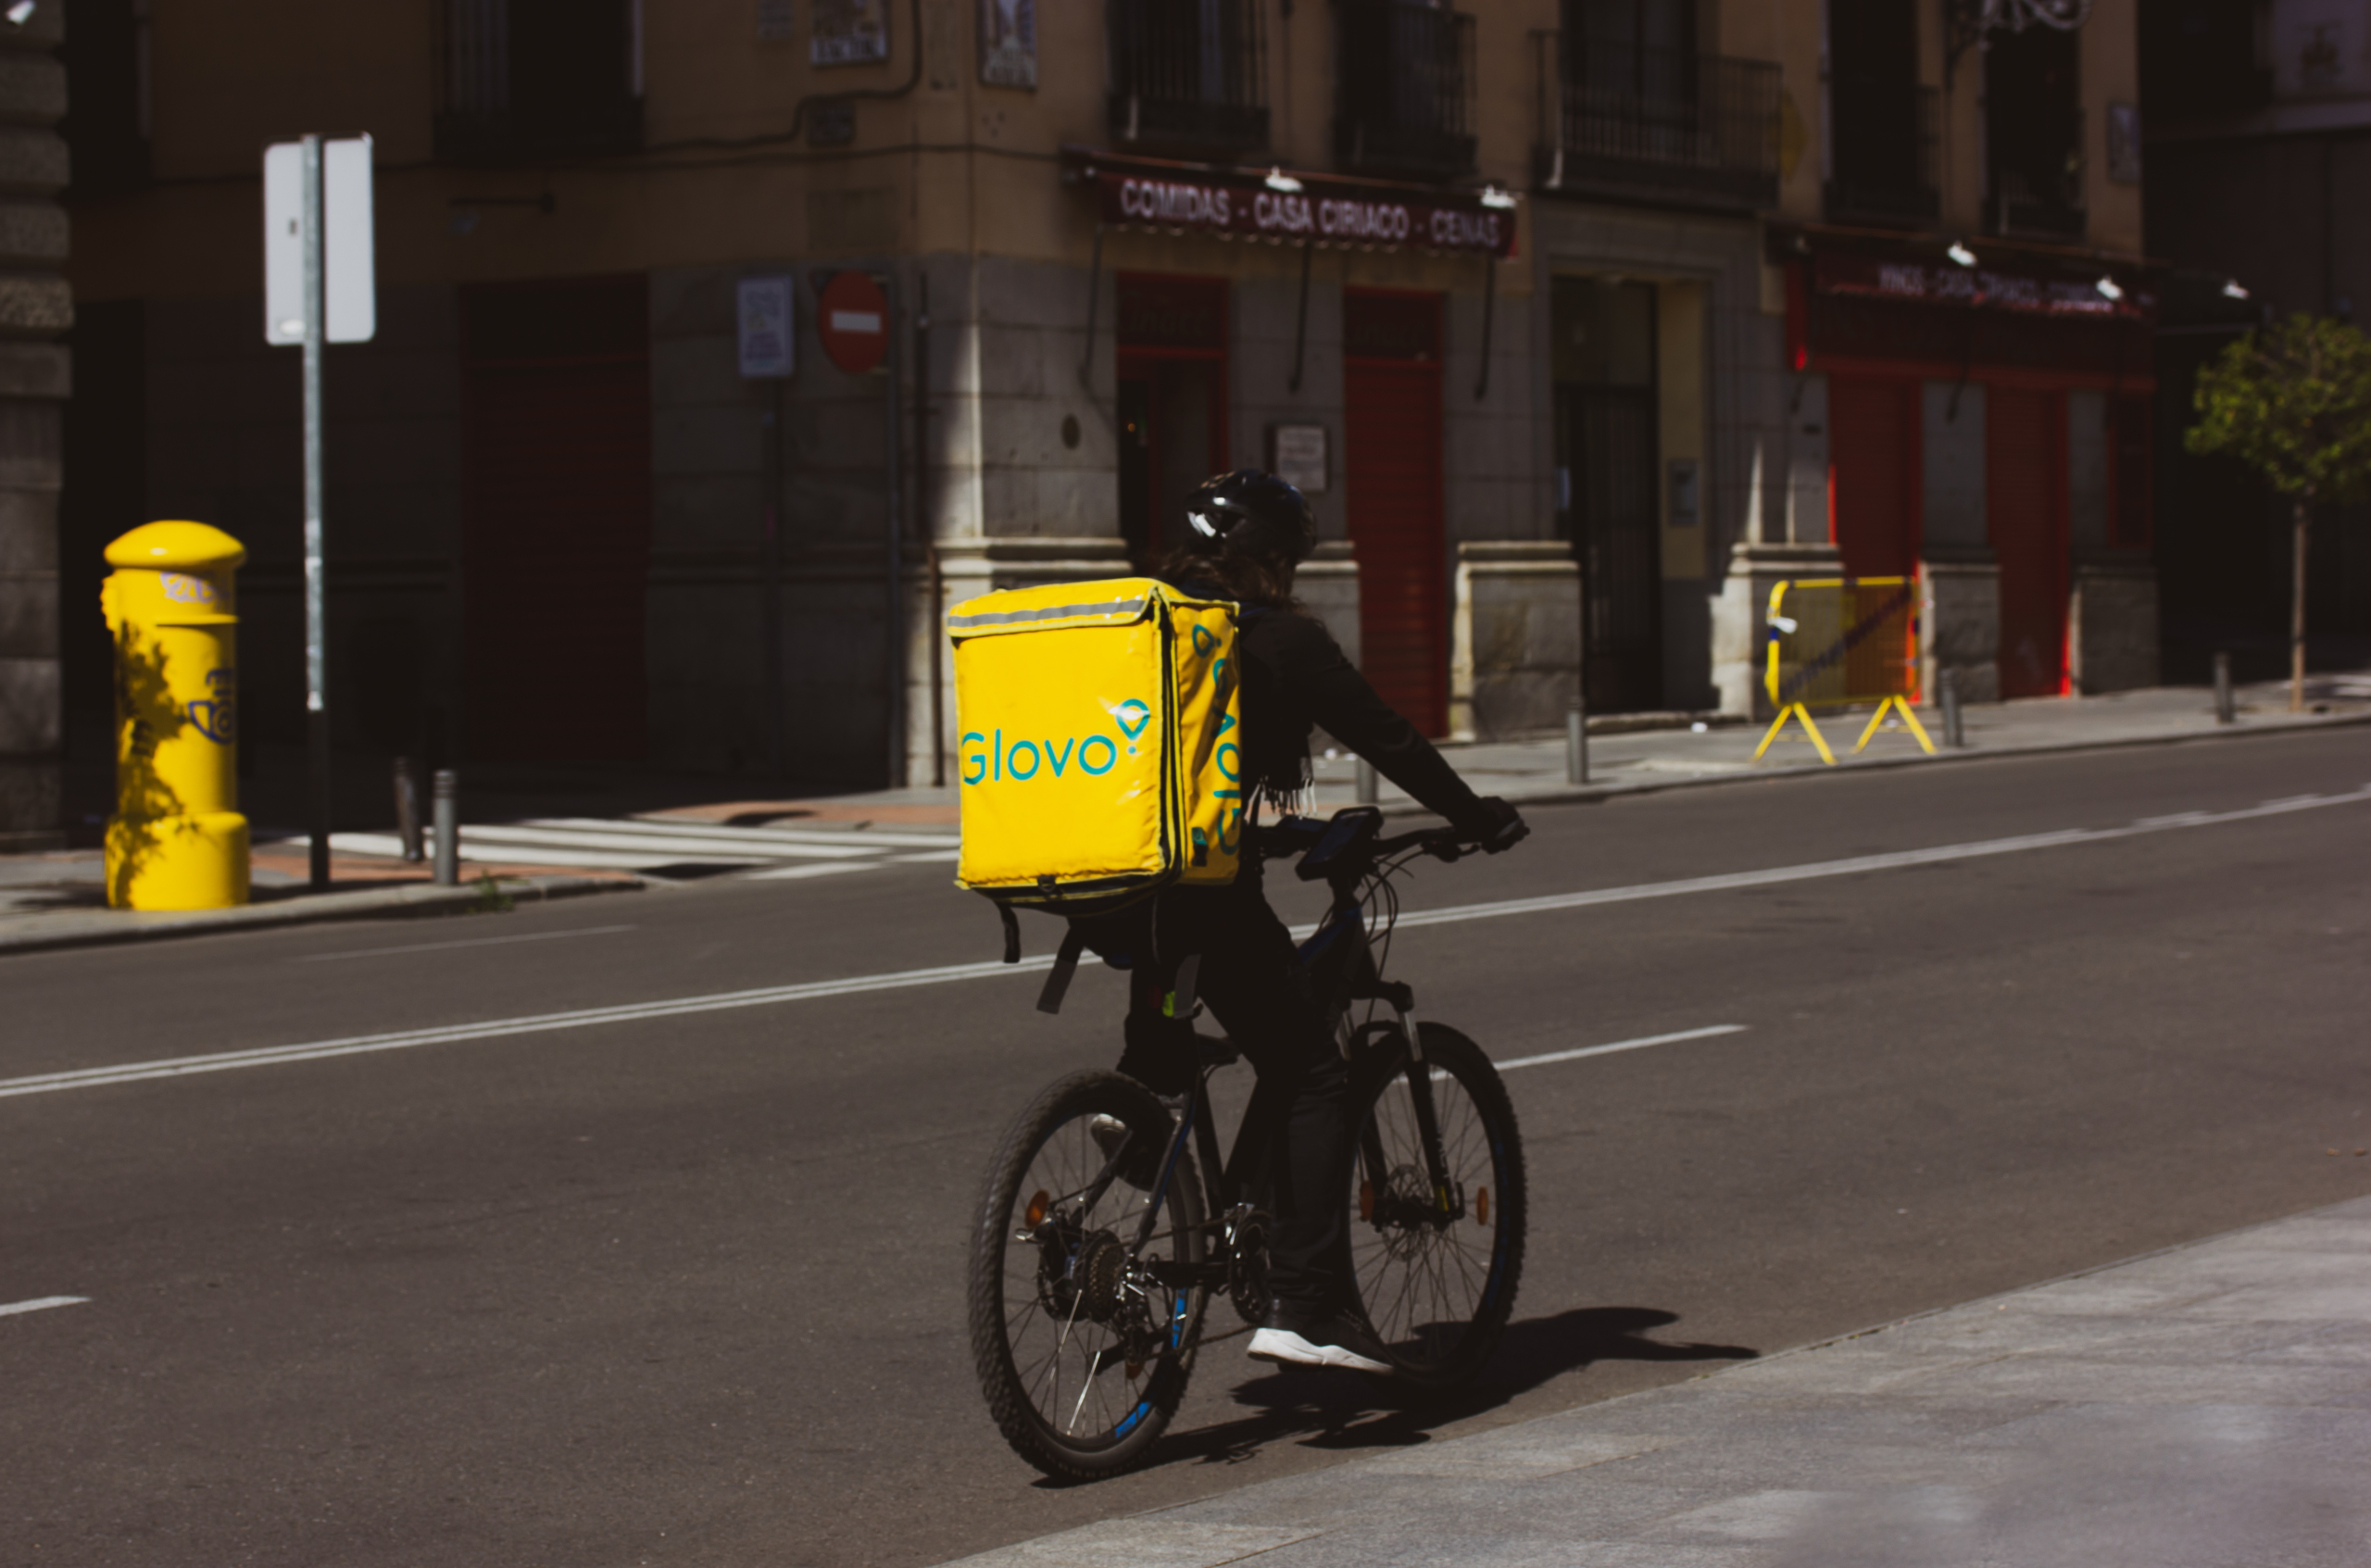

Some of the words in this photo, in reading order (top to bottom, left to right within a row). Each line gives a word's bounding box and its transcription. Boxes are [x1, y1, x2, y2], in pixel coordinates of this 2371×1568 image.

[1120, 179, 1231, 226] COMIDAS
[1253, 192, 1314, 232] CASA
[1319, 198, 1410, 240] CIRIACO
[1429, 209, 1500, 248] CENAS
[961, 728, 1117, 785] Glovo
